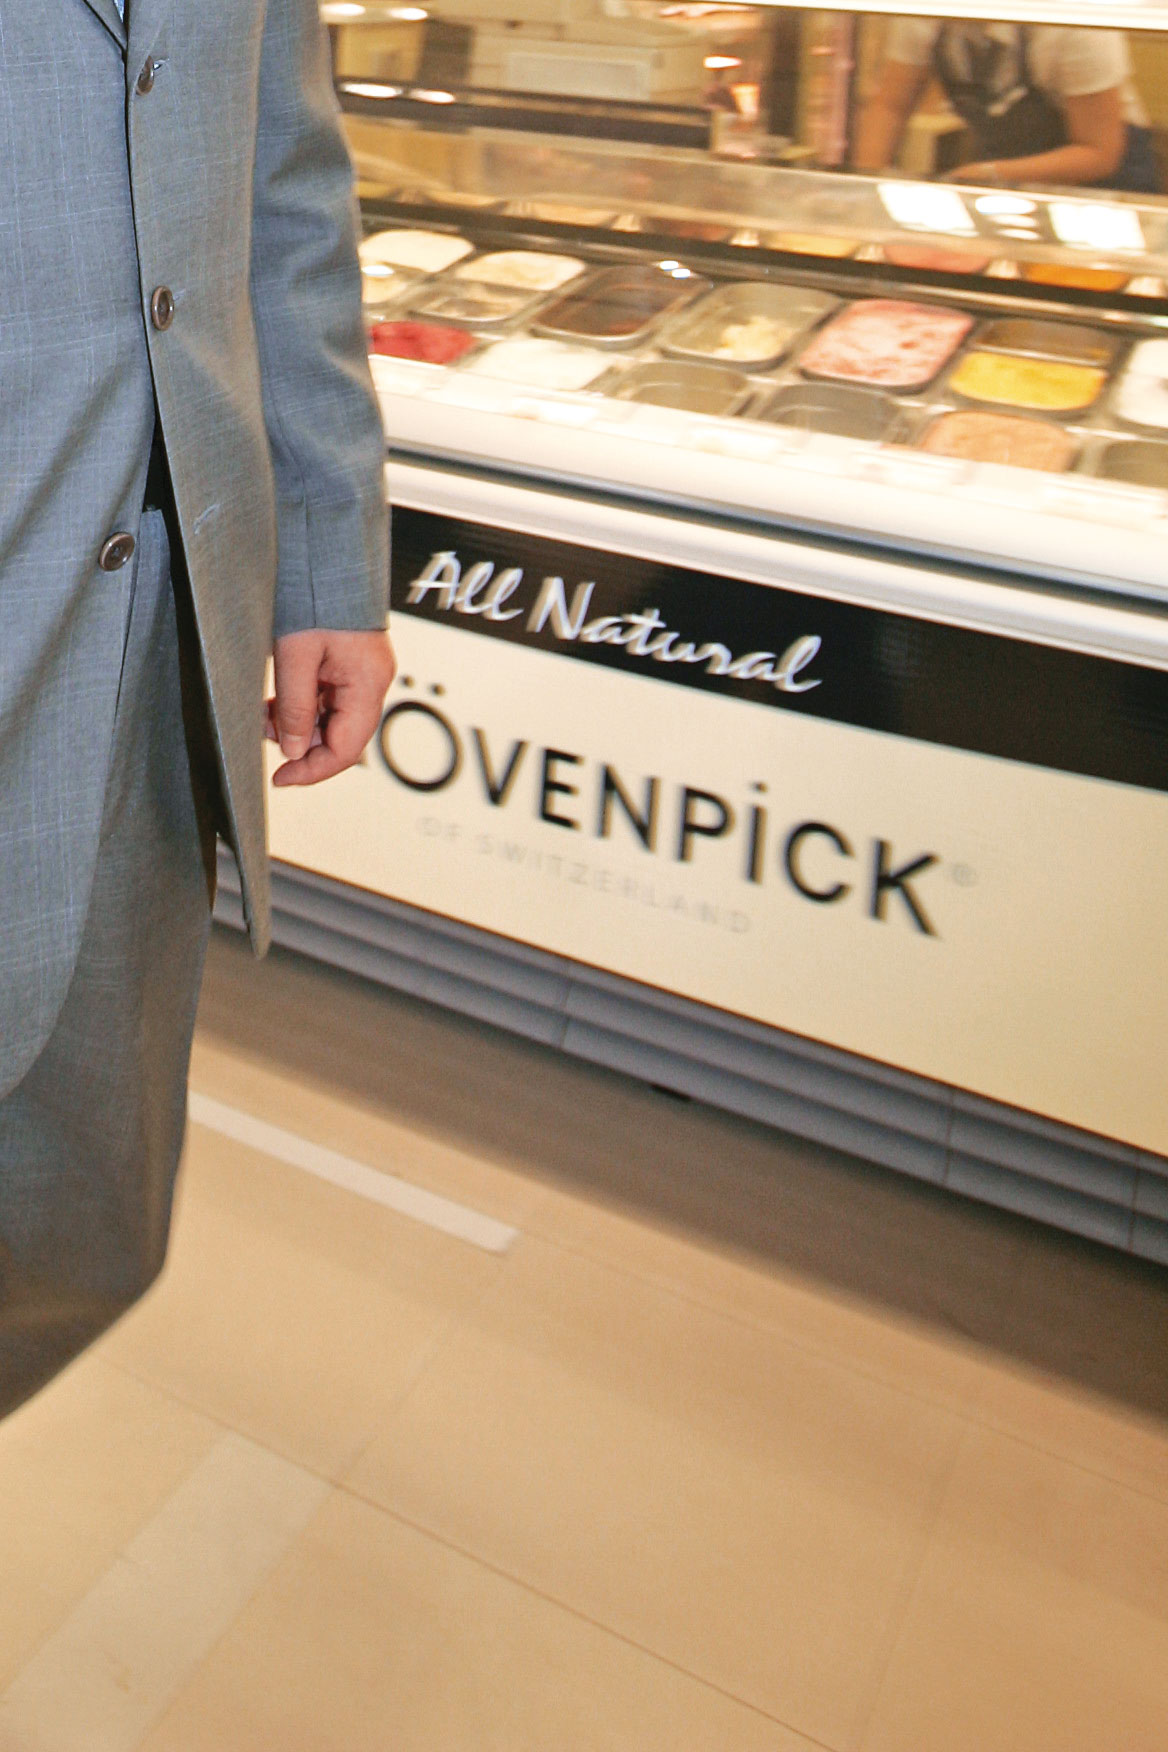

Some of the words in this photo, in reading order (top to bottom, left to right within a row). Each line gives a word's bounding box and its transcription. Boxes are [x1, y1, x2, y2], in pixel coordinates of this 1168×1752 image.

[408, 549, 525, 622] All
[524, 575, 824, 694] Natural
[356, 674, 946, 940] ÖVENPiCK
[476, 832, 753, 935] SWITZERLAND
